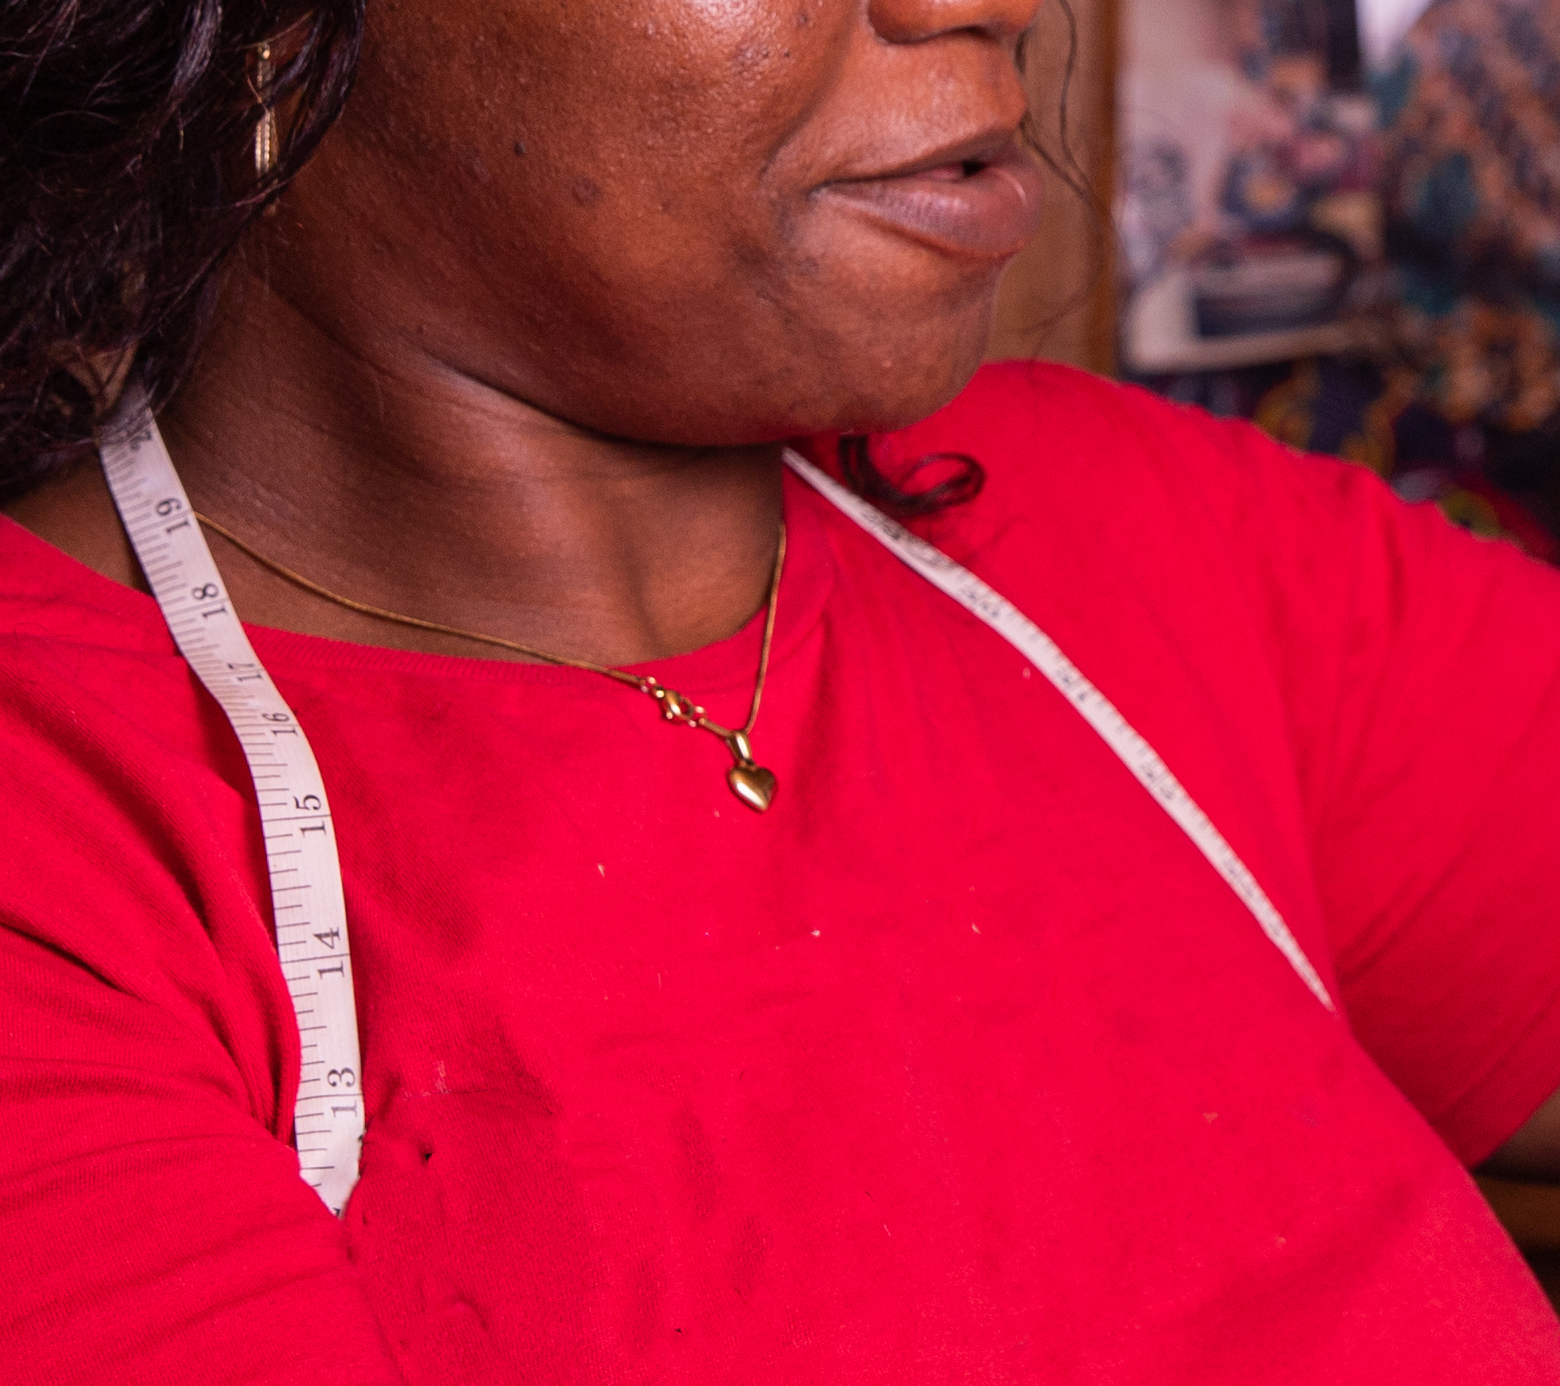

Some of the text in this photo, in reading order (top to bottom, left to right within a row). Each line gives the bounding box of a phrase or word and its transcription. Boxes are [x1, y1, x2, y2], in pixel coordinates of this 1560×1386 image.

[155, 496, 191, 535] 19
[192, 582, 228, 619] 18
[227, 660, 263, 684] 17
[261, 711, 298, 738] 16
[294, 793, 327, 839] 15
[312, 926, 346, 980] 14
[326, 1066, 359, 1119] 13
